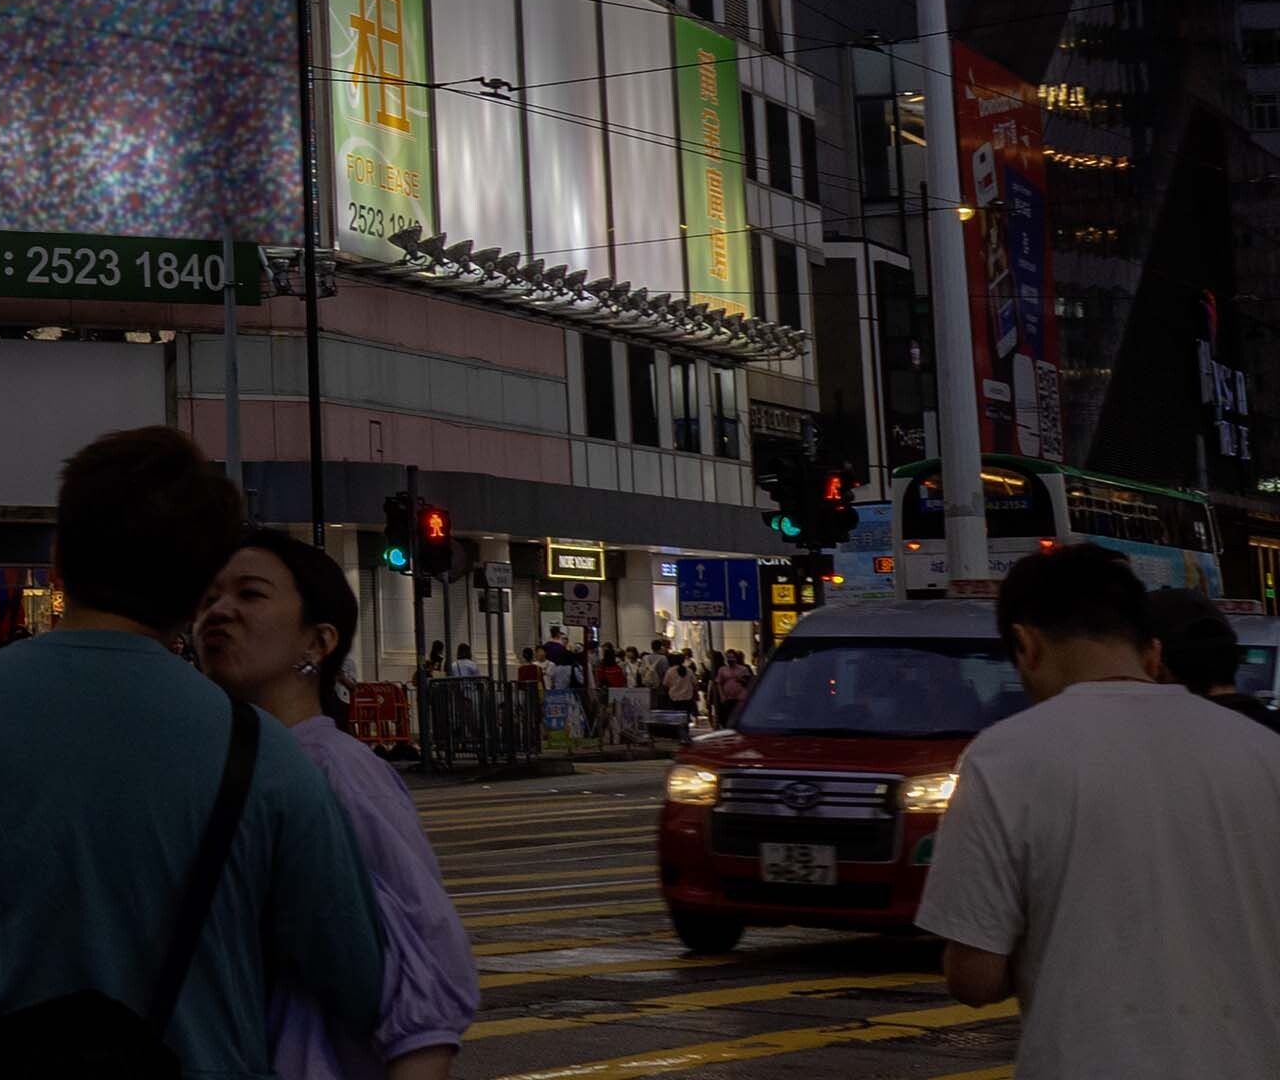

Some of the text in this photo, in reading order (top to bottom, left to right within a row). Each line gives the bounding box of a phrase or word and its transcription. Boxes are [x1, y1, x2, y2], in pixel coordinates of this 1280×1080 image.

[347, 151, 421, 199] FOR LEASE
[348, 201, 422, 238] 2523 18
[26, 246, 121, 287] 2523
[136, 251, 226, 292] 1840
